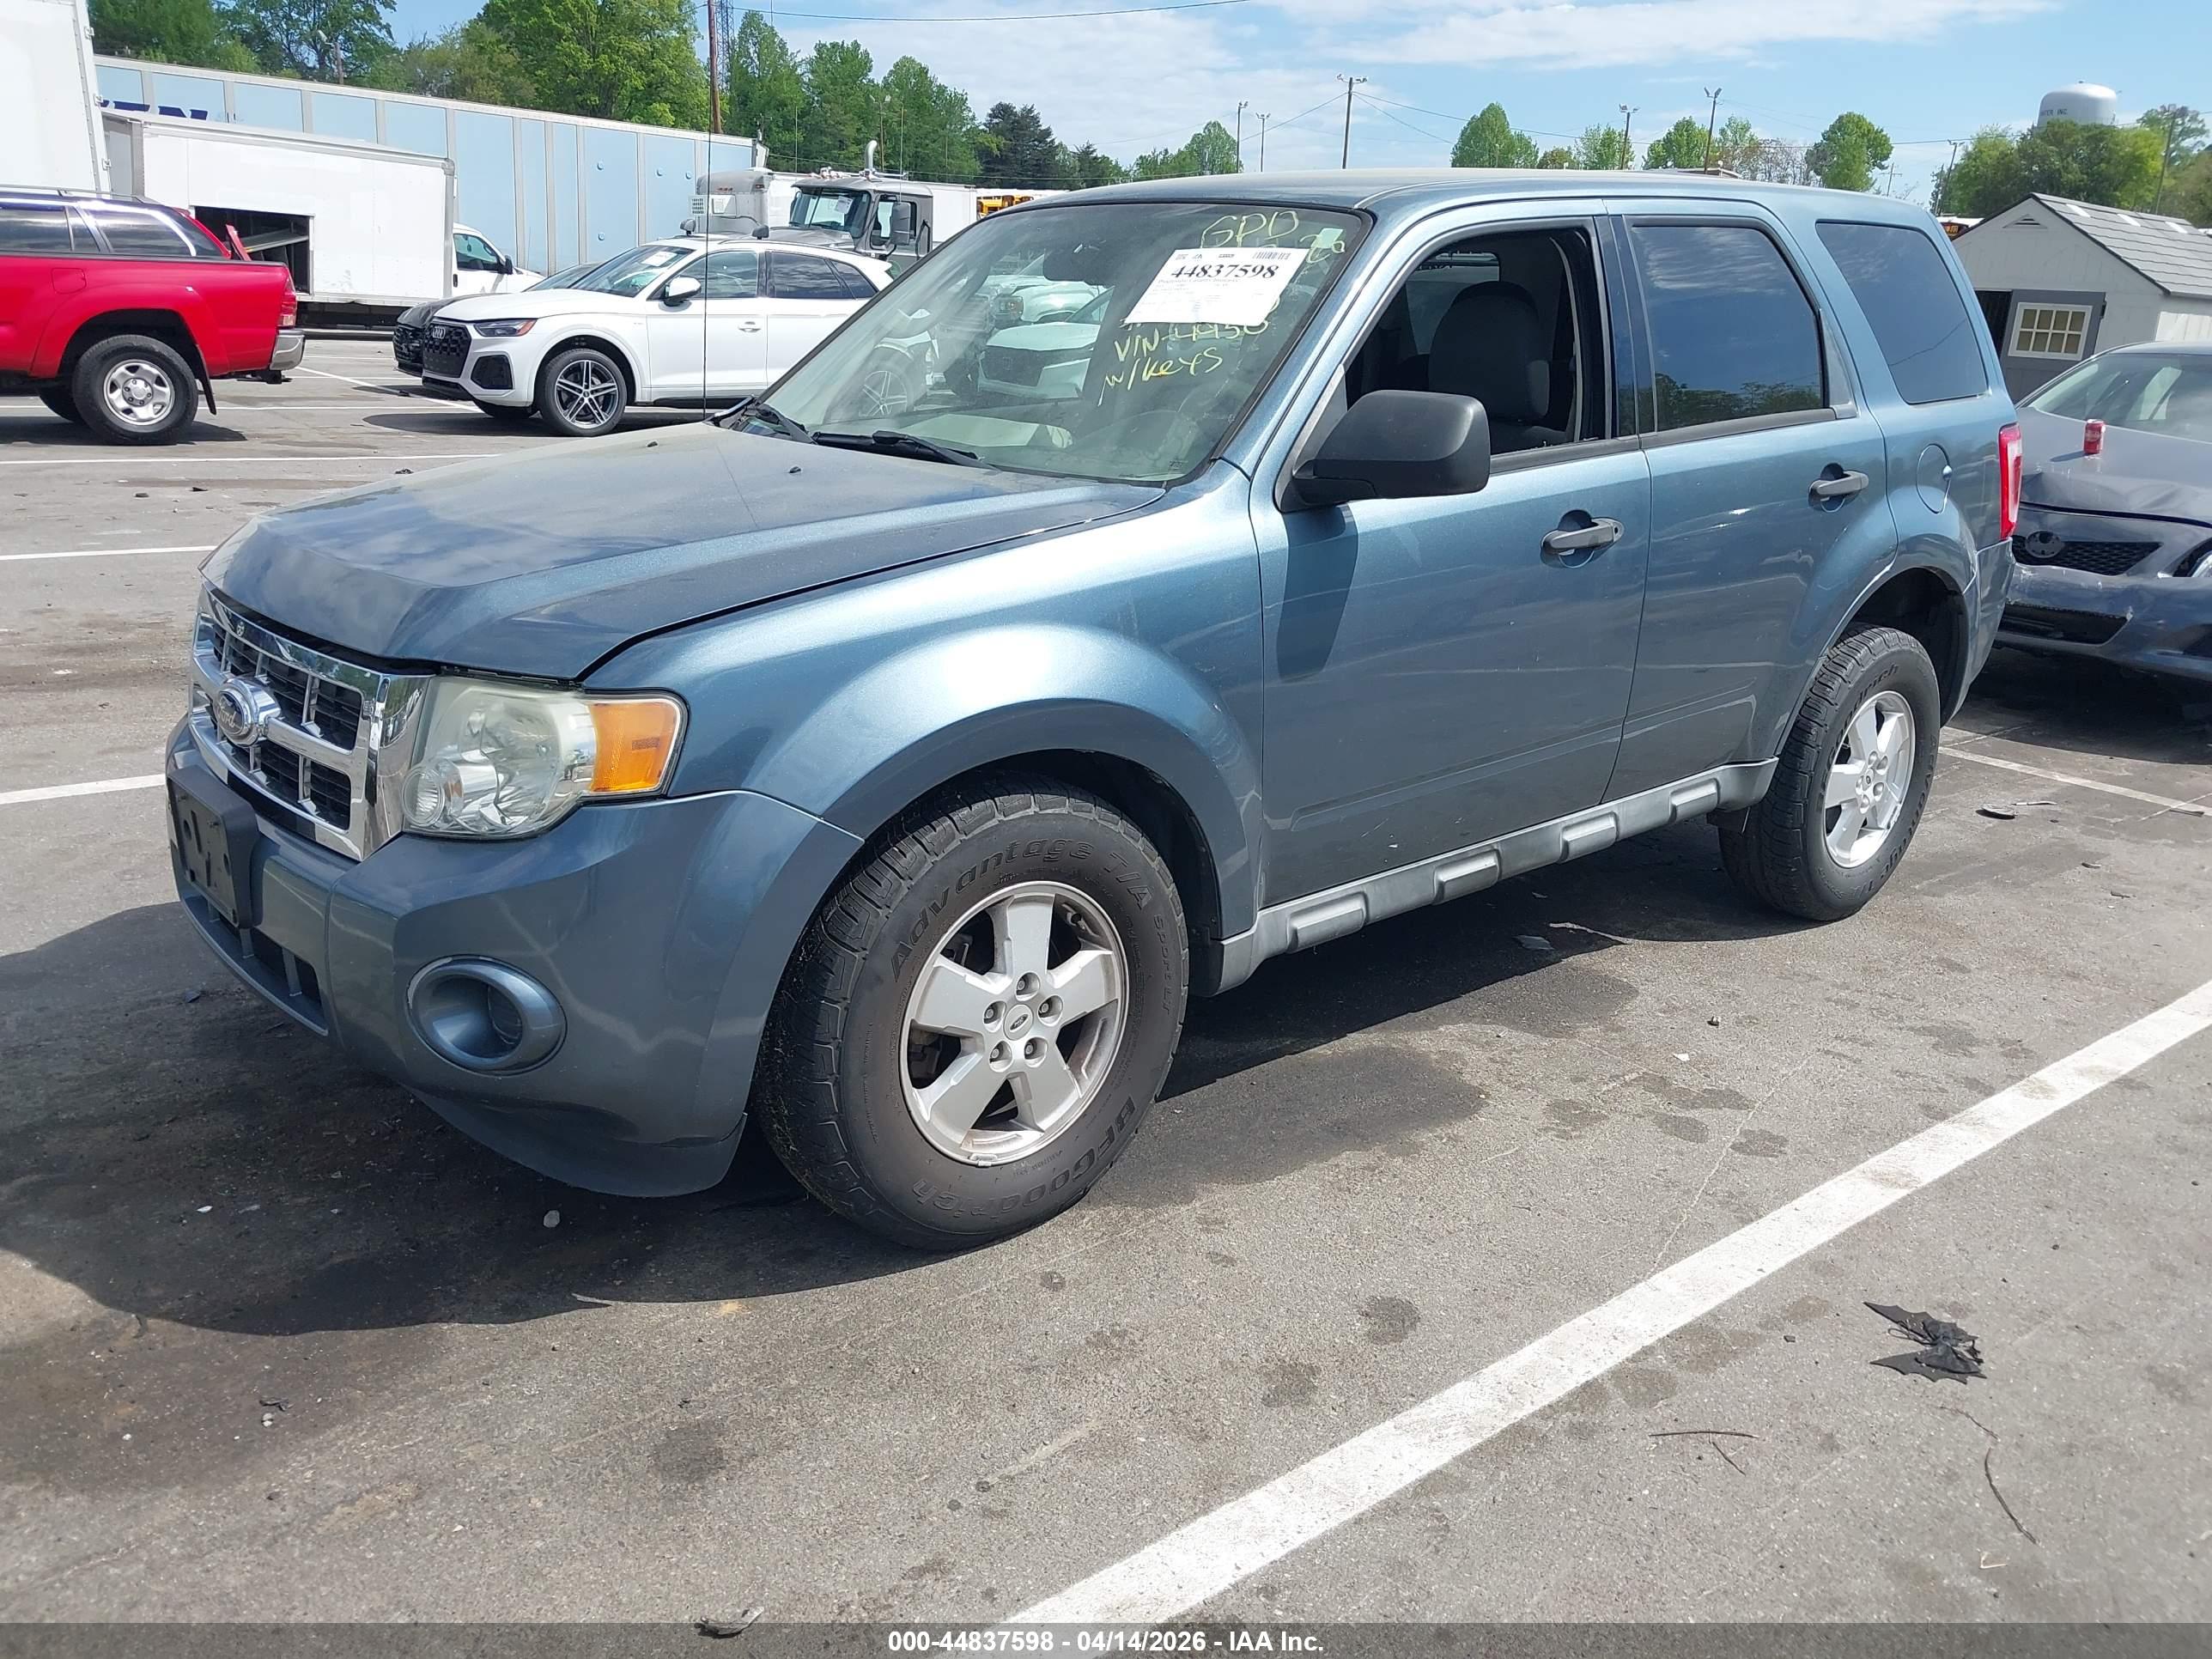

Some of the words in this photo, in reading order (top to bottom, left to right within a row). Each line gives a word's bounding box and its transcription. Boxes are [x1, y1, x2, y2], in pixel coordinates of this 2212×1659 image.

[1171, 264, 1279, 279] 44837598
[218, 696, 237, 728] Ford
[890, 837, 1095, 982] Advantage
[1103, 852, 1153, 911] T/A
[912, 1096, 1136, 1219] BFGoodrich
